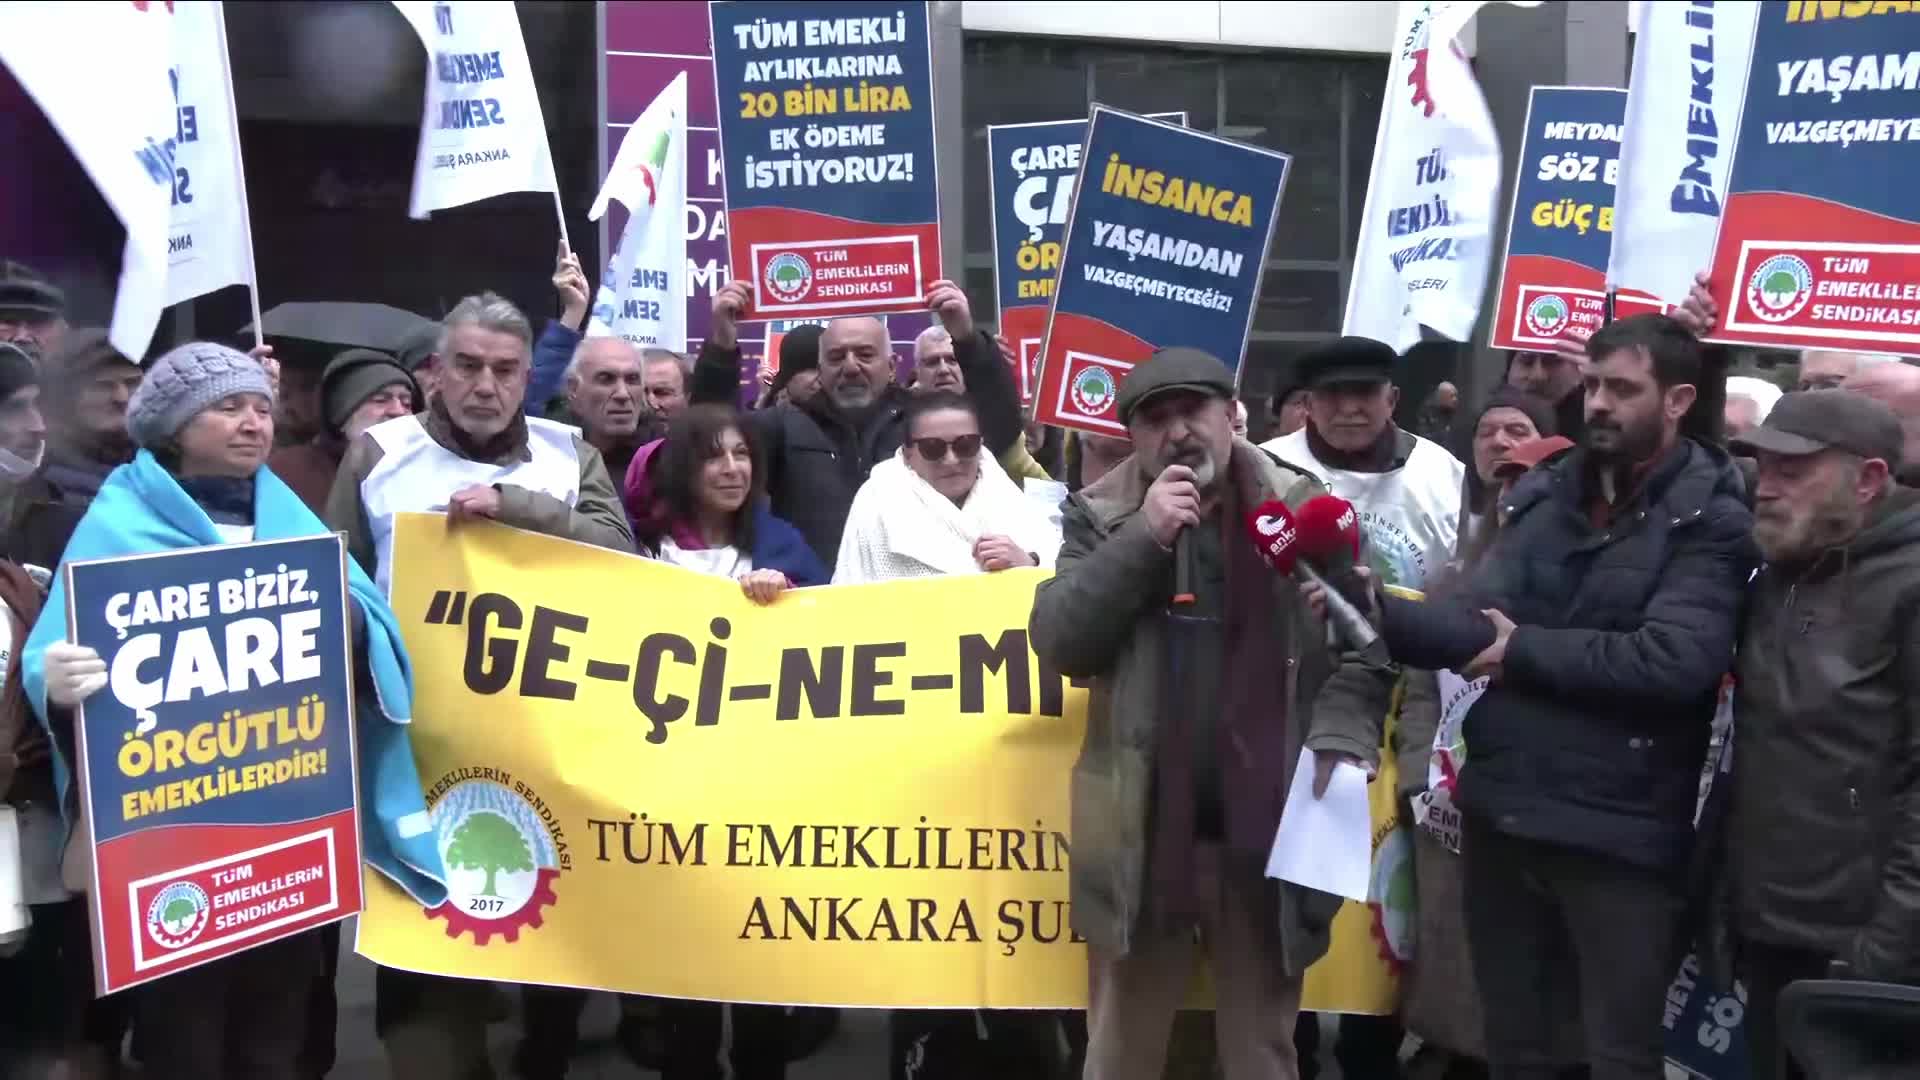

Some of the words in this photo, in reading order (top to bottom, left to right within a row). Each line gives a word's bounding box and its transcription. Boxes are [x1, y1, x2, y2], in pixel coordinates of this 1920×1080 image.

[733, 19, 798, 50] TÜM
[804, 10, 906, 46] EMEKLİ
[744, 54, 904, 83] AYLIKLARINA
[1777, 51, 1920, 104] YAŞAM
[740, 94, 778, 118] 20
[784, 82, 838, 116] BİN
[844, 80, 912, 113] LİRA
[1671, 0, 1720, 217] EMEKLİ
[770, 128, 800, 151] EK
[804, 124, 886, 148] ÖDEME
[744, 152, 914, 189] İSTİYORUZ!
[1011, 144, 1082, 178] ÇARE
[1537, 151, 1600, 182] SÖZ
[1101, 152, 1253, 228] İNSANCA
[1531, 198, 1594, 235] GÜÇ
[814, 250, 848, 263] TÜM
[1092, 220, 1243, 278] YAŞAMDAN
[1823, 257, 1870, 274] TÜM
[815, 263, 910, 281] EMEKLİLERİN
[817, 282, 893, 297] SENDİKASI
[1083, 264, 1233, 312] VAZGEÇMEYECEĞİZ!
[105, 592, 210, 641] ÇARE
[218, 563, 319, 615] BİZİZ,
[110, 608, 322, 735] ÇARE
[118, 694, 326, 778] ÖRGÜTLÜ
[121, 748, 328, 822] EMEKLİLERDİR!
[514, 781, 572, 872] SENDİKASI
[587, 812, 708, 866] TÜM
[211, 864, 253, 888] TÜM
[213, 865, 324, 909] EMEKLİLERİN
[470, 898, 504, 912] 2017
[738, 896, 982, 942] ANKARA
